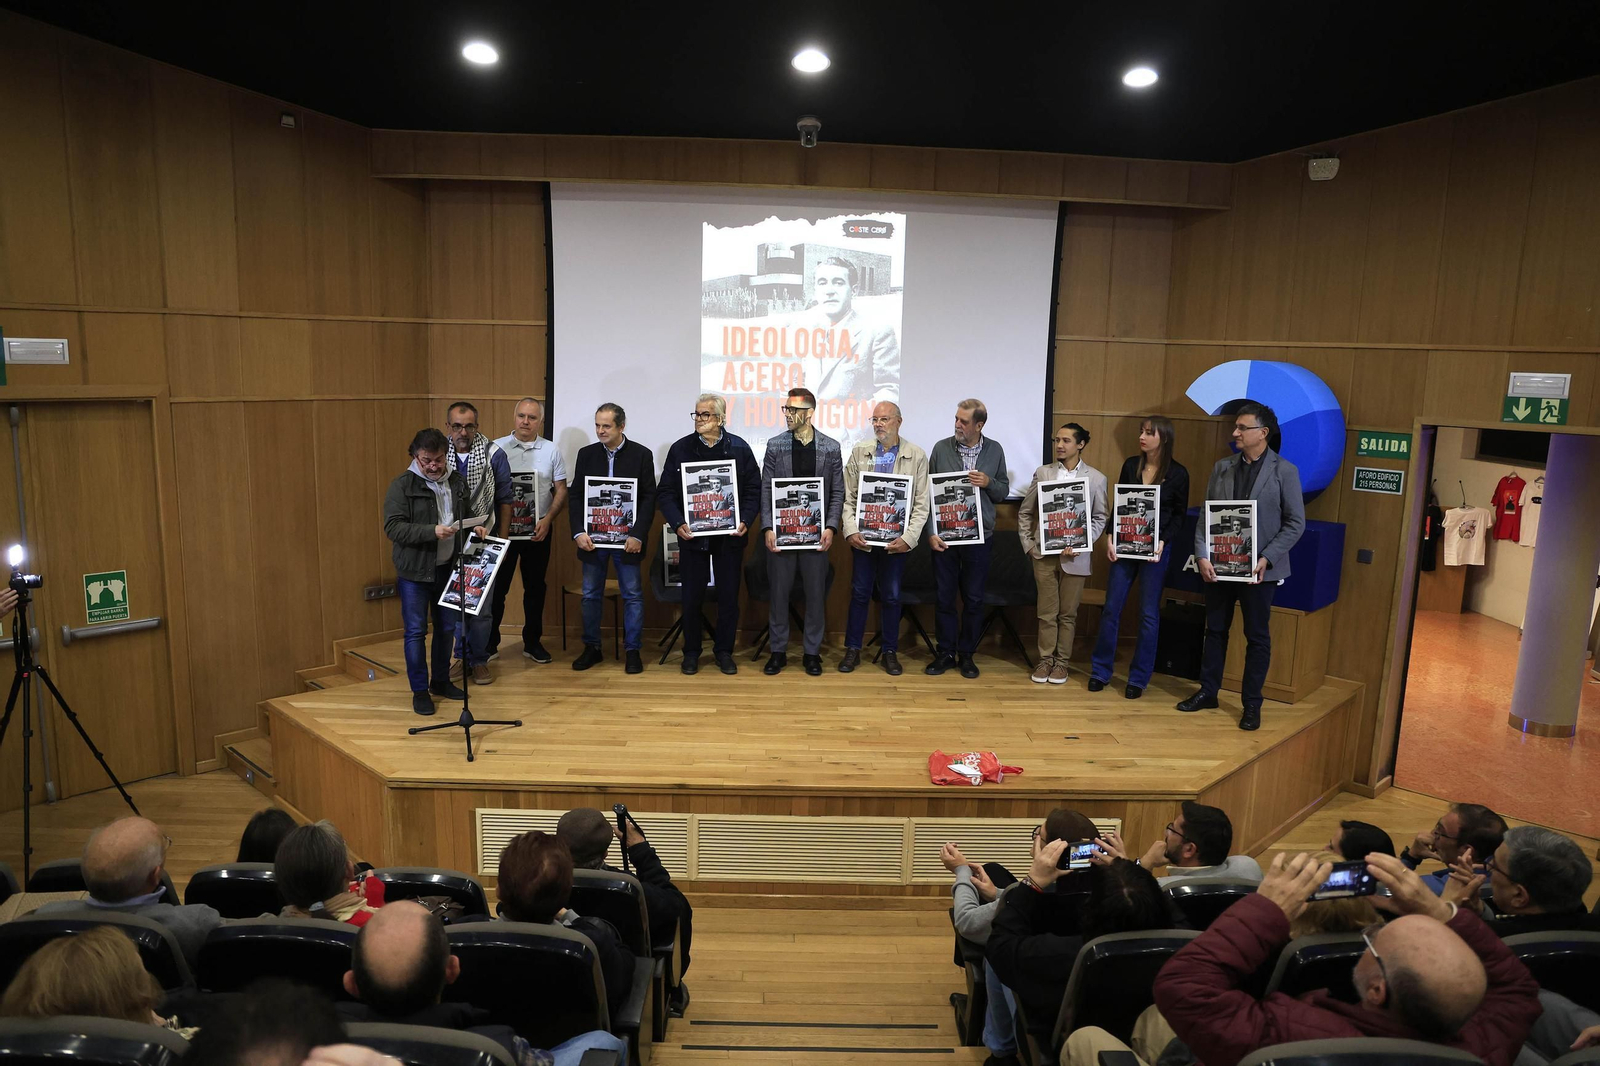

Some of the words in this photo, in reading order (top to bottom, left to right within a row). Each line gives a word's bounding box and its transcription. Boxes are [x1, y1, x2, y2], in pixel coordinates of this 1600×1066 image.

[722, 361, 803, 392] ACERO
[1360, 437, 1408, 453] SALIDA
[1358, 471, 1377, 480] AFORO
[1377, 472, 1400, 482] EDIFICIO
[1359, 480, 1368, 488] 215
[1368, 481, 1397, 490] PERSONAS
